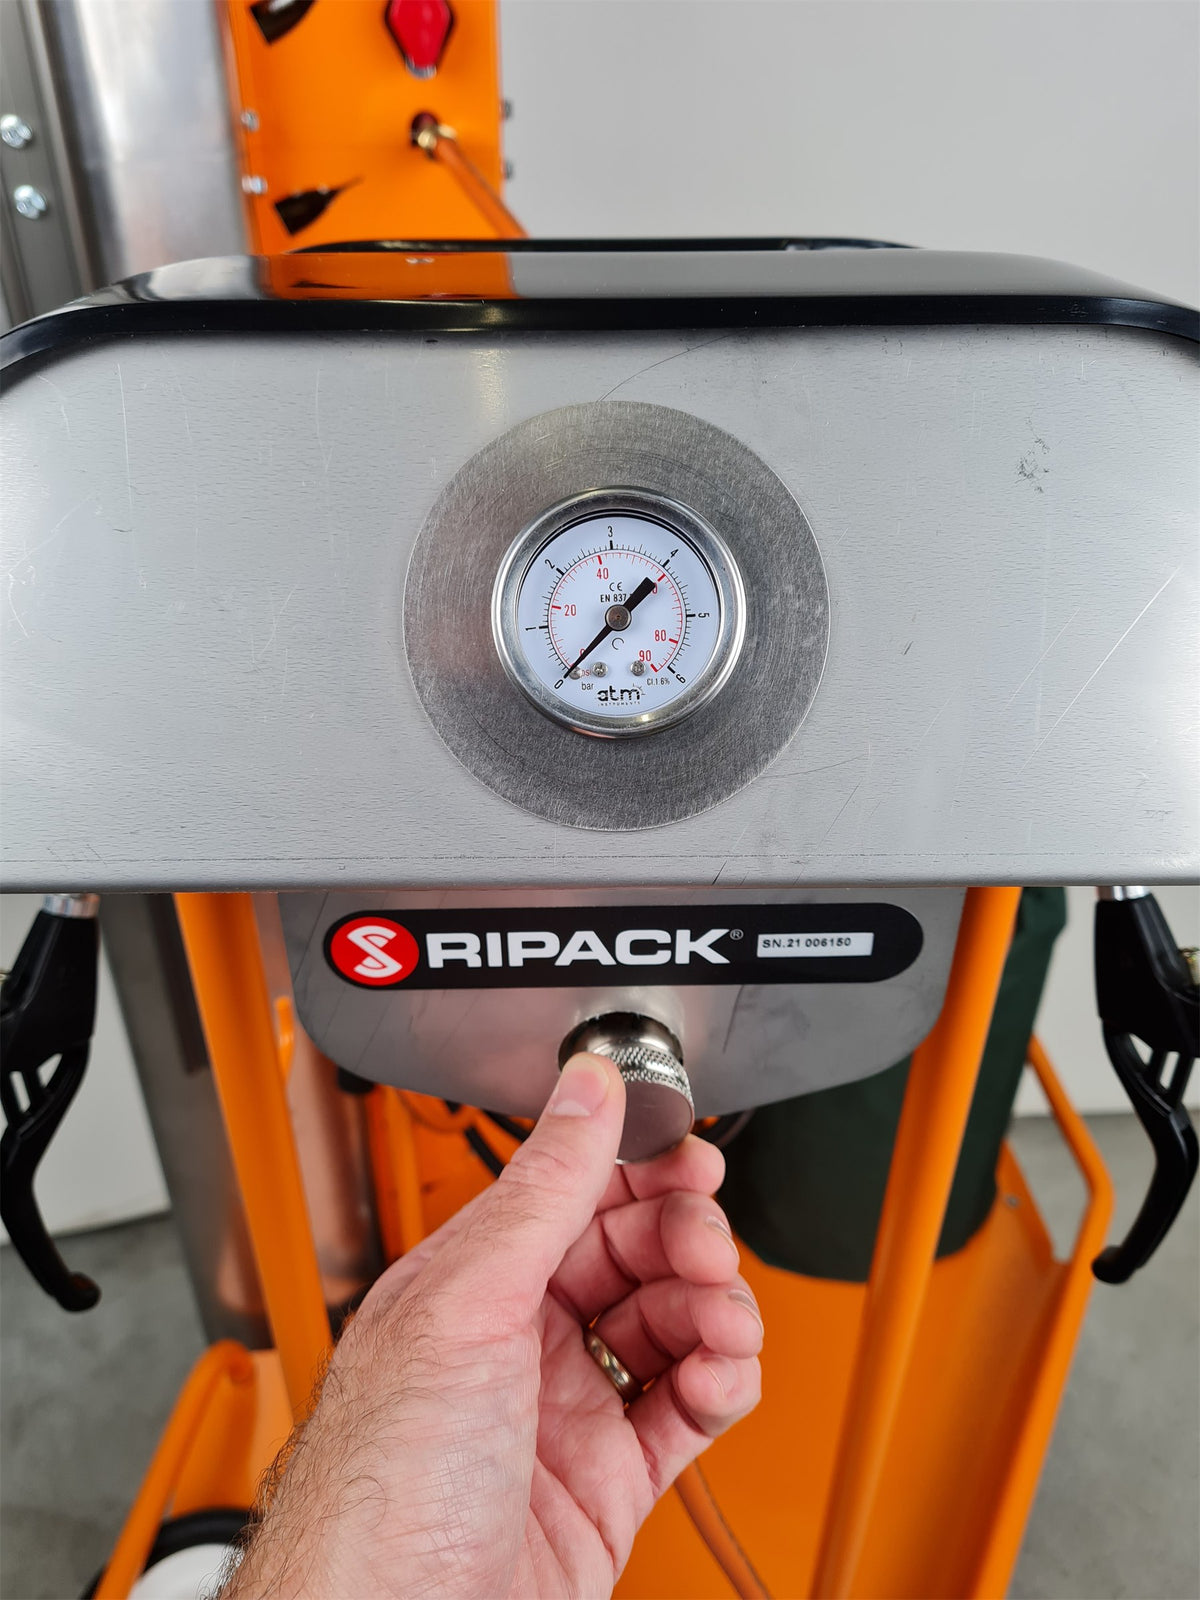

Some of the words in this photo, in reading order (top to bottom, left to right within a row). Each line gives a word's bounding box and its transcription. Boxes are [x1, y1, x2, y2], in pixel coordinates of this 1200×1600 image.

[608, 525, 613, 537] 3
[670, 548, 679, 558] 4
[544, 558, 555, 569] 2
[596, 567, 609, 580] 40
[600, 594, 610, 603] EN
[613, 593, 630, 603] 837
[564, 604, 577, 616] 20
[654, 629, 667, 642] 80
[638, 649, 652, 662] 90
[554, 679, 564, 689] 0
[675, 673, 686, 684] 6
[581, 681, 594, 690] bar
[597, 685, 640, 701] atm
[762, 938, 801, 948] SN.21
[805, 937, 852, 948] 006150
